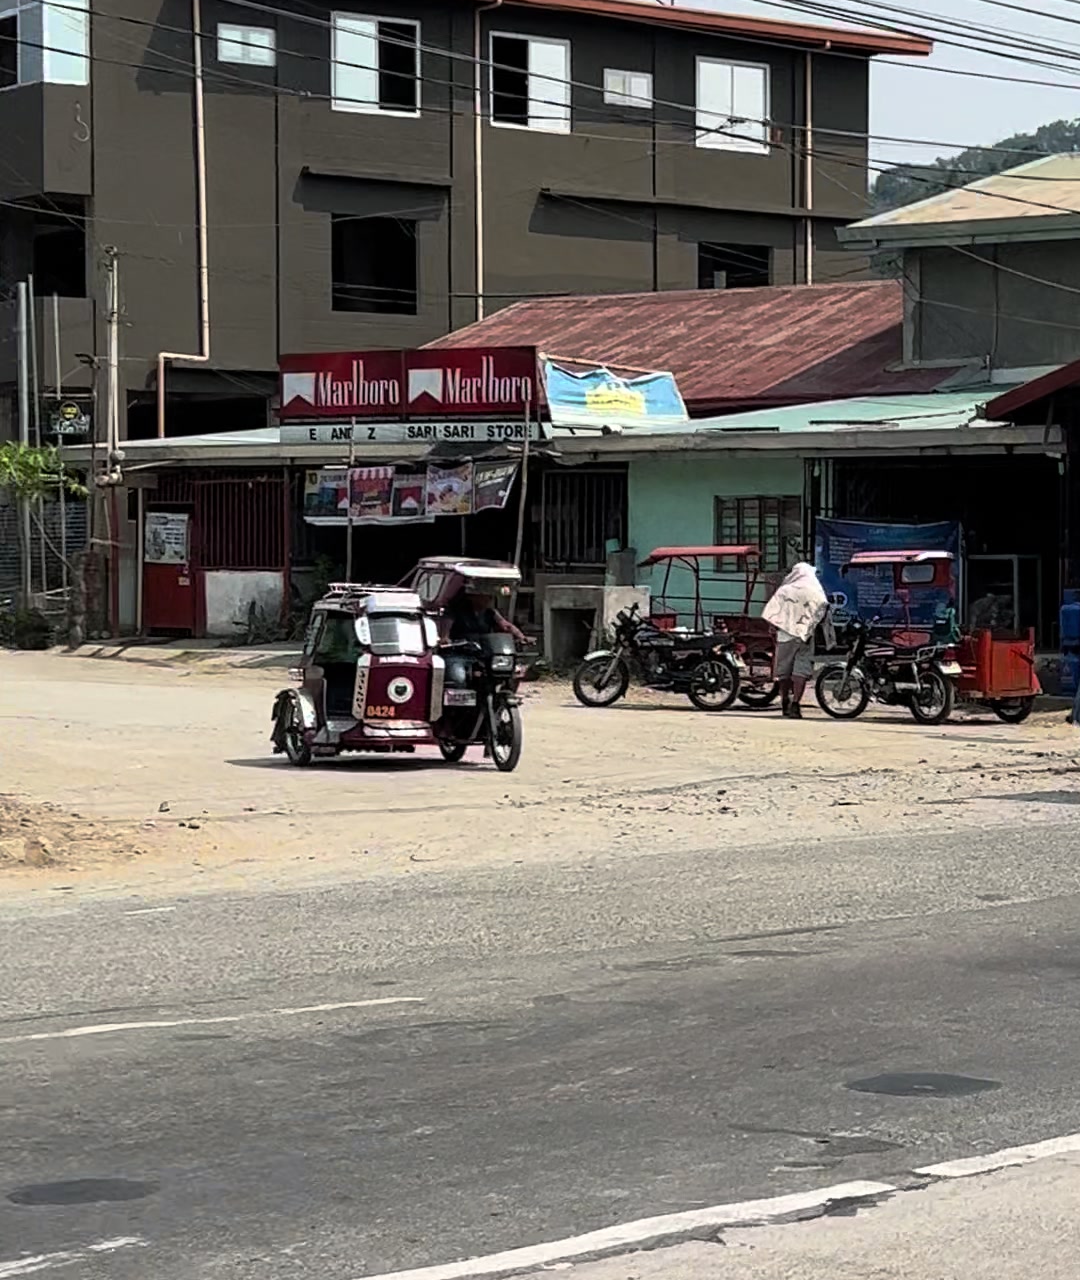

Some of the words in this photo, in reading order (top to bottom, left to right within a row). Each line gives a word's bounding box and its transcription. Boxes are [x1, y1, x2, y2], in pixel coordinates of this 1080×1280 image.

[317, 359, 399, 407] Marlboro
[446, 355, 532, 405] Marlboro
[309, 428, 317, 441] E
[367, 427, 376, 440] Z
[486, 424, 533, 438] STORE
[366, 705, 396, 717] 0424
